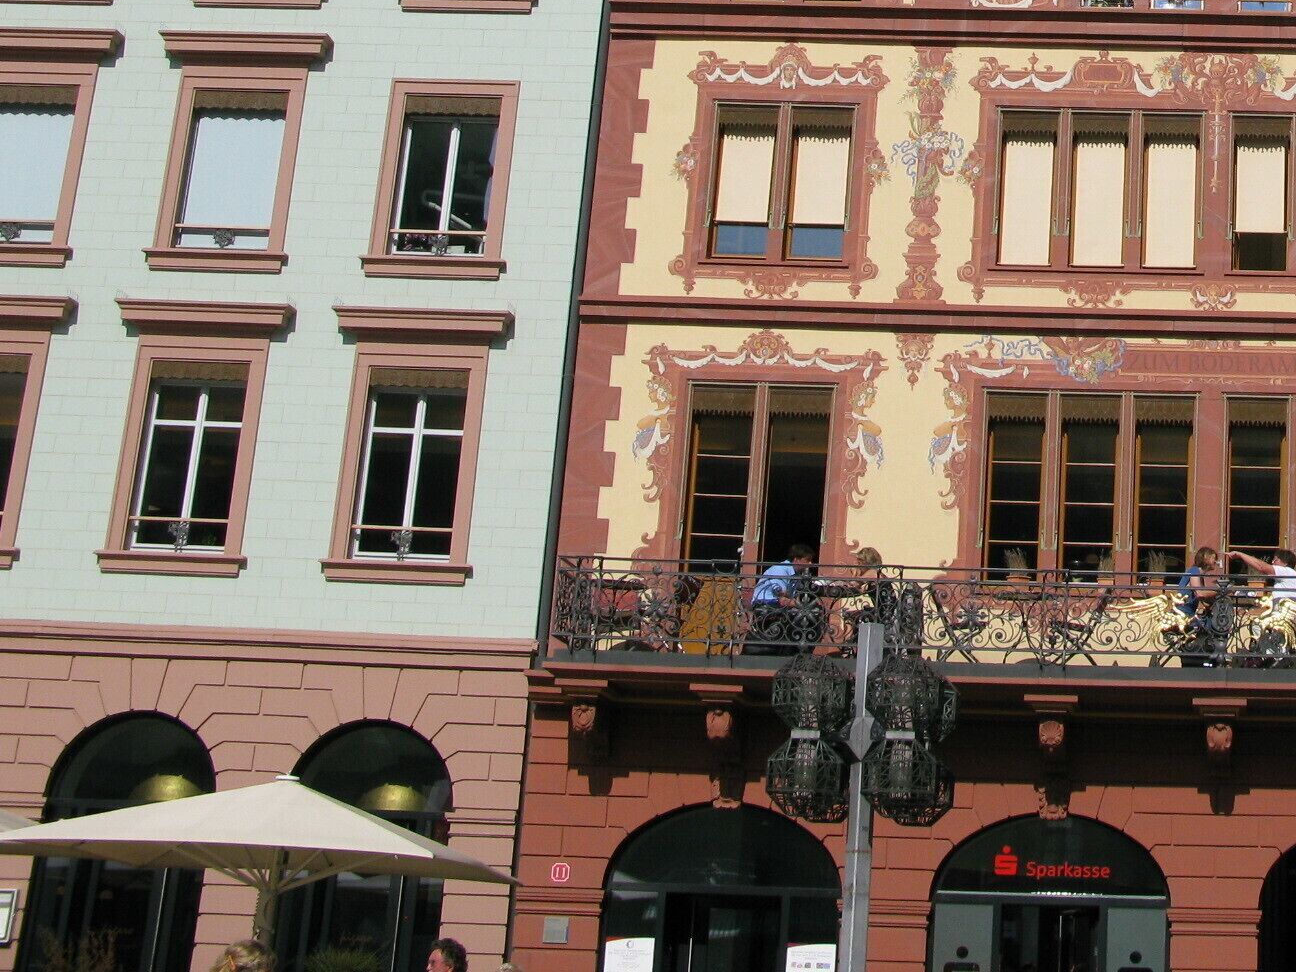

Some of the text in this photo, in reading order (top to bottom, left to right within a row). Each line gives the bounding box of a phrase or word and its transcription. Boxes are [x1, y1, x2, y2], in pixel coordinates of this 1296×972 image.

[1128, 353, 1180, 371] ZUM
[555, 866, 567, 878] 11
[1026, 861, 1111, 879] Sparkasse
